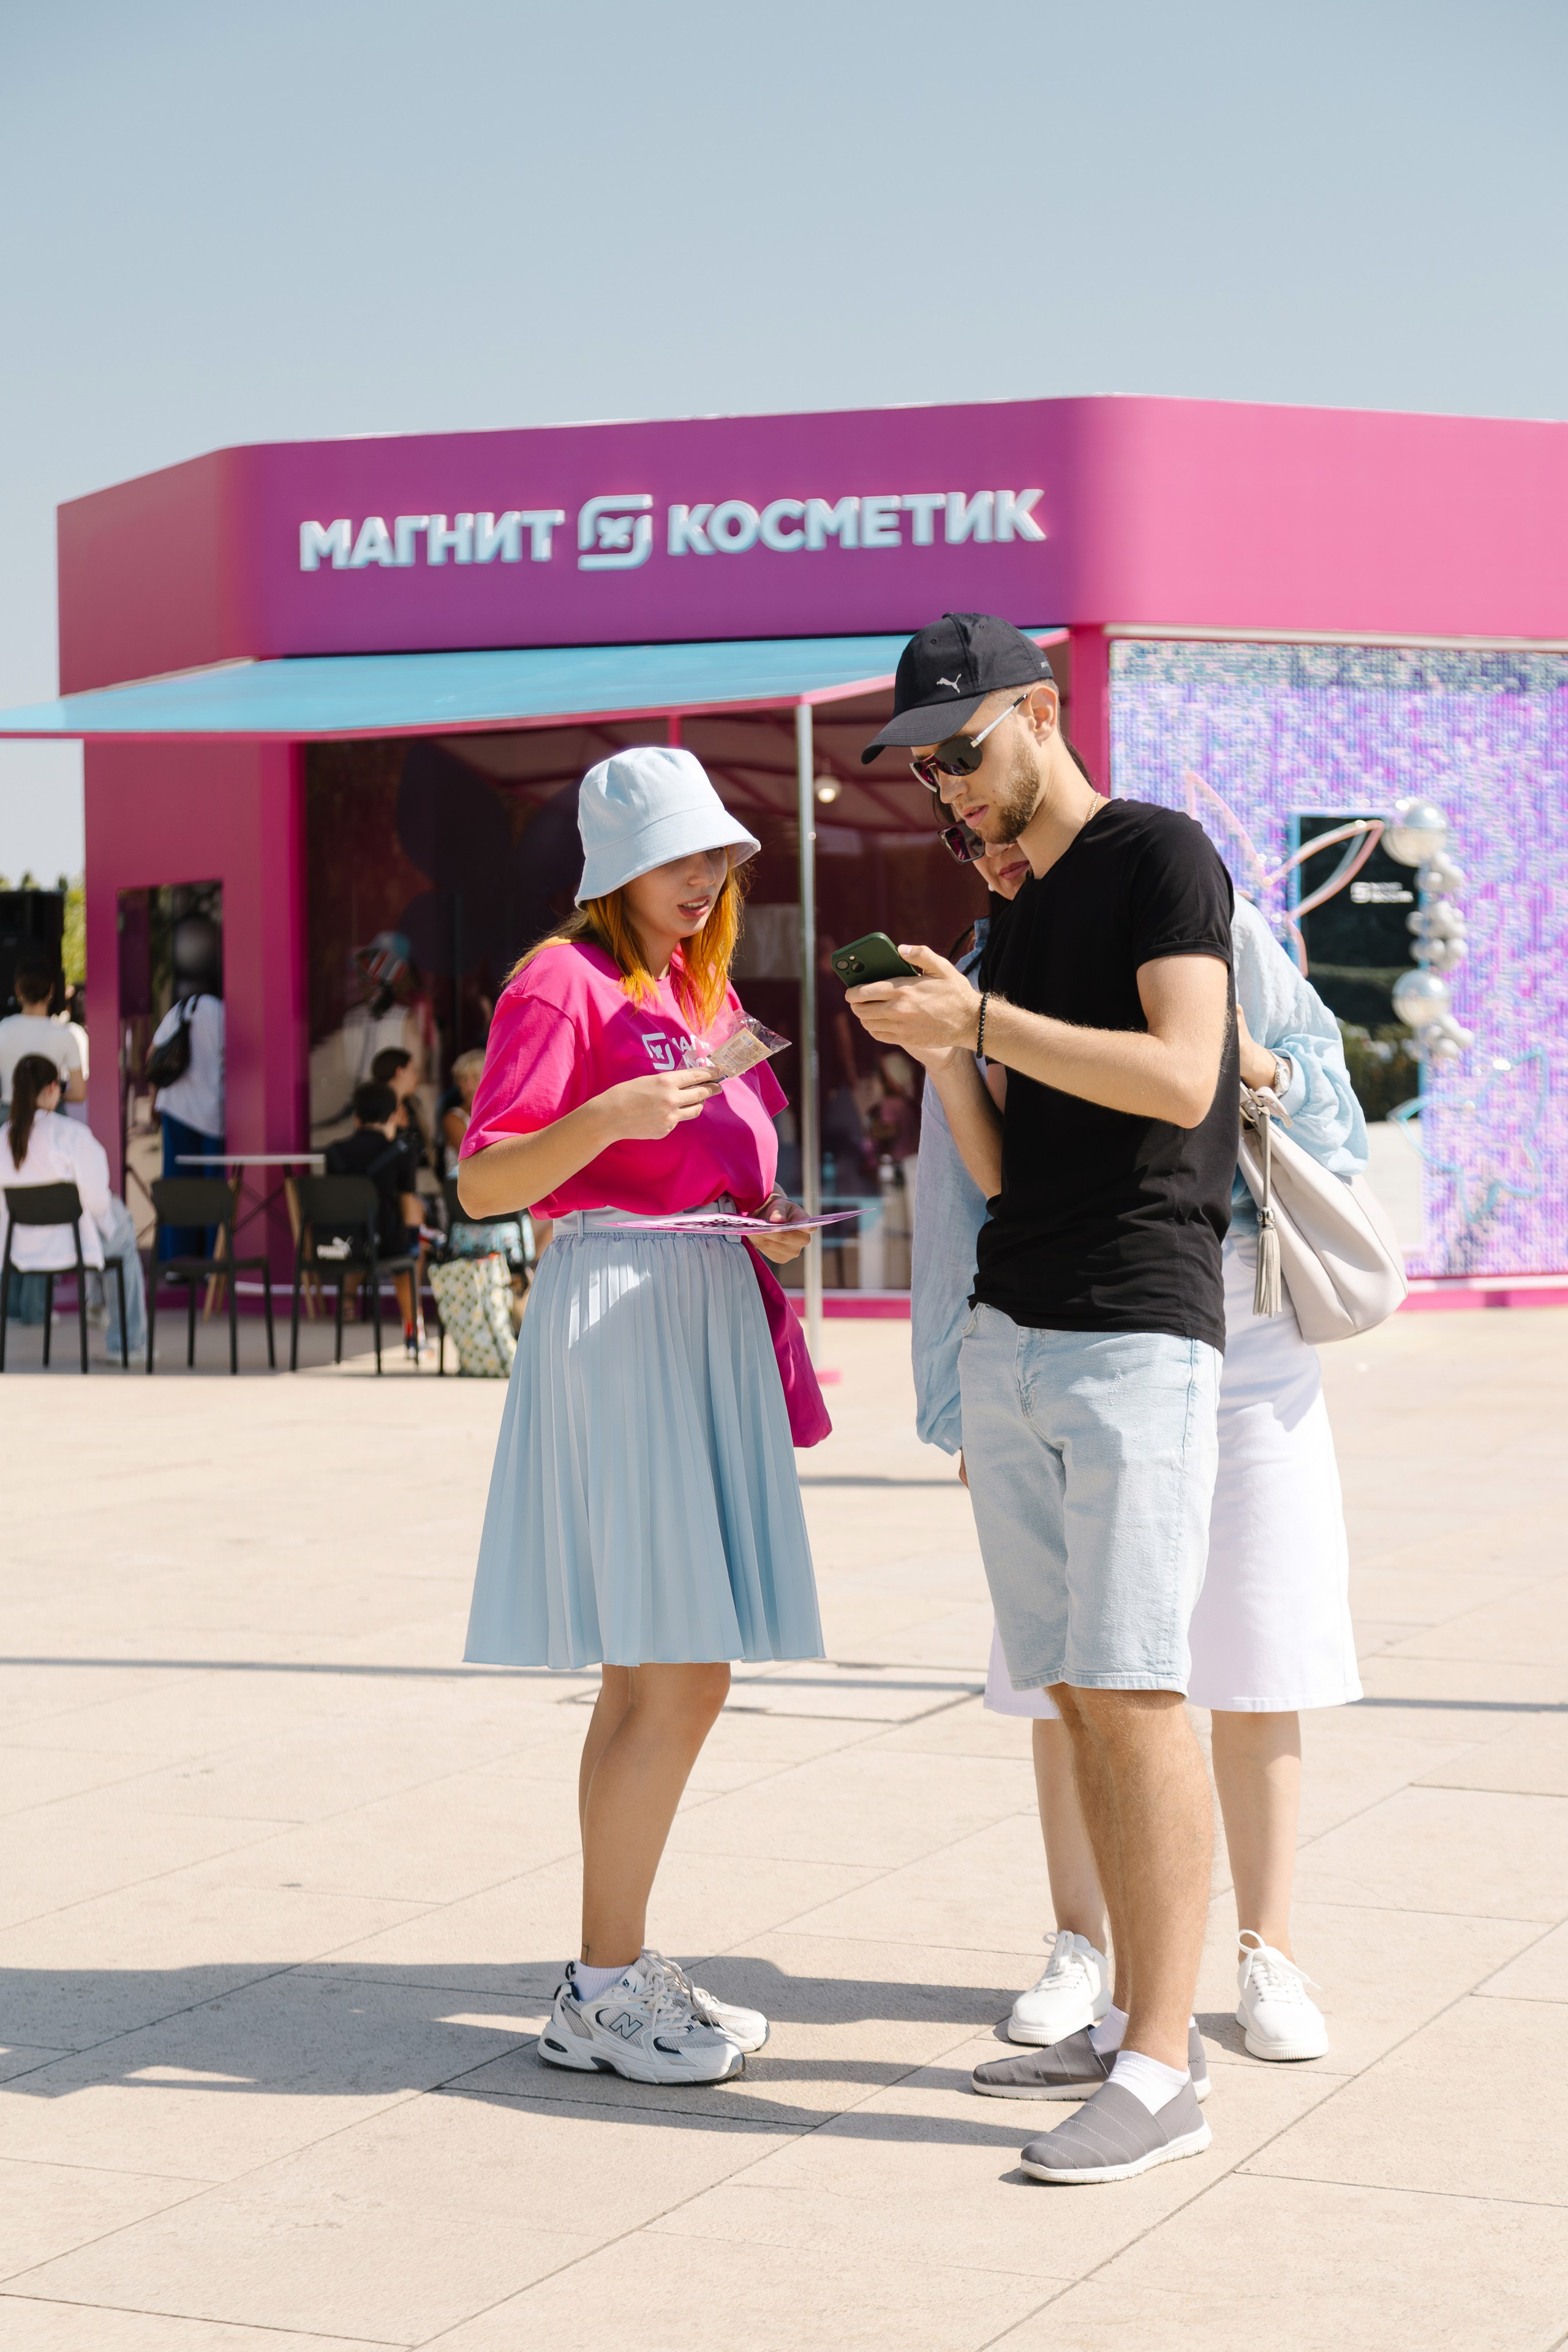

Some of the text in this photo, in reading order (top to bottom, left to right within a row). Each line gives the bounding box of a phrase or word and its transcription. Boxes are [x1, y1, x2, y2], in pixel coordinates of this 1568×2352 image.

[300, 488, 1047, 571] МАГНИТ КОСМЕТИК
[609, 2012, 643, 2040] N
